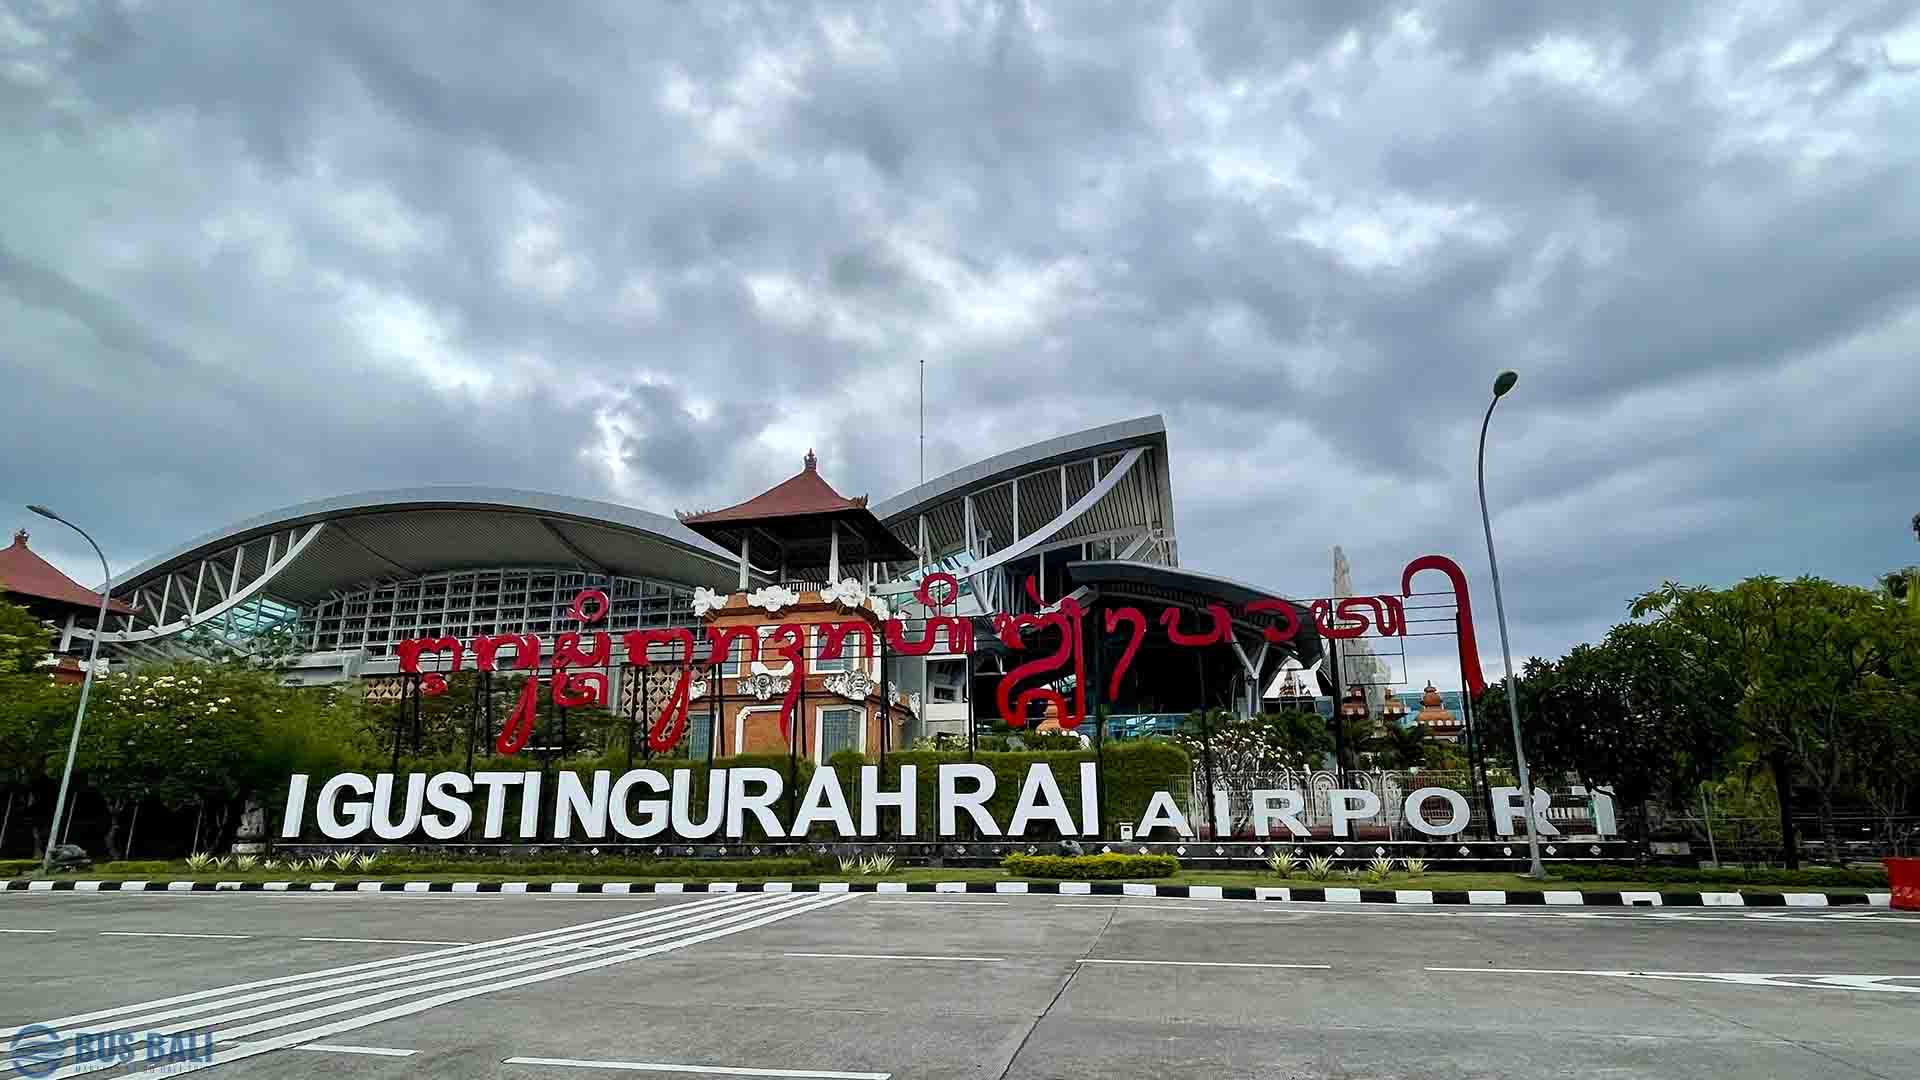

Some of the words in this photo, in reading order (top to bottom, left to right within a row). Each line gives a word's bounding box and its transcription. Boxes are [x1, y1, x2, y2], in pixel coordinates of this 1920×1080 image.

[281, 773, 309, 839] I
[316, 771, 543, 840] GUSTI
[553, 764, 918, 840] NGURAH
[939, 762, 1101, 837] RAI
[1135, 785, 1618, 838] AIRPORT
